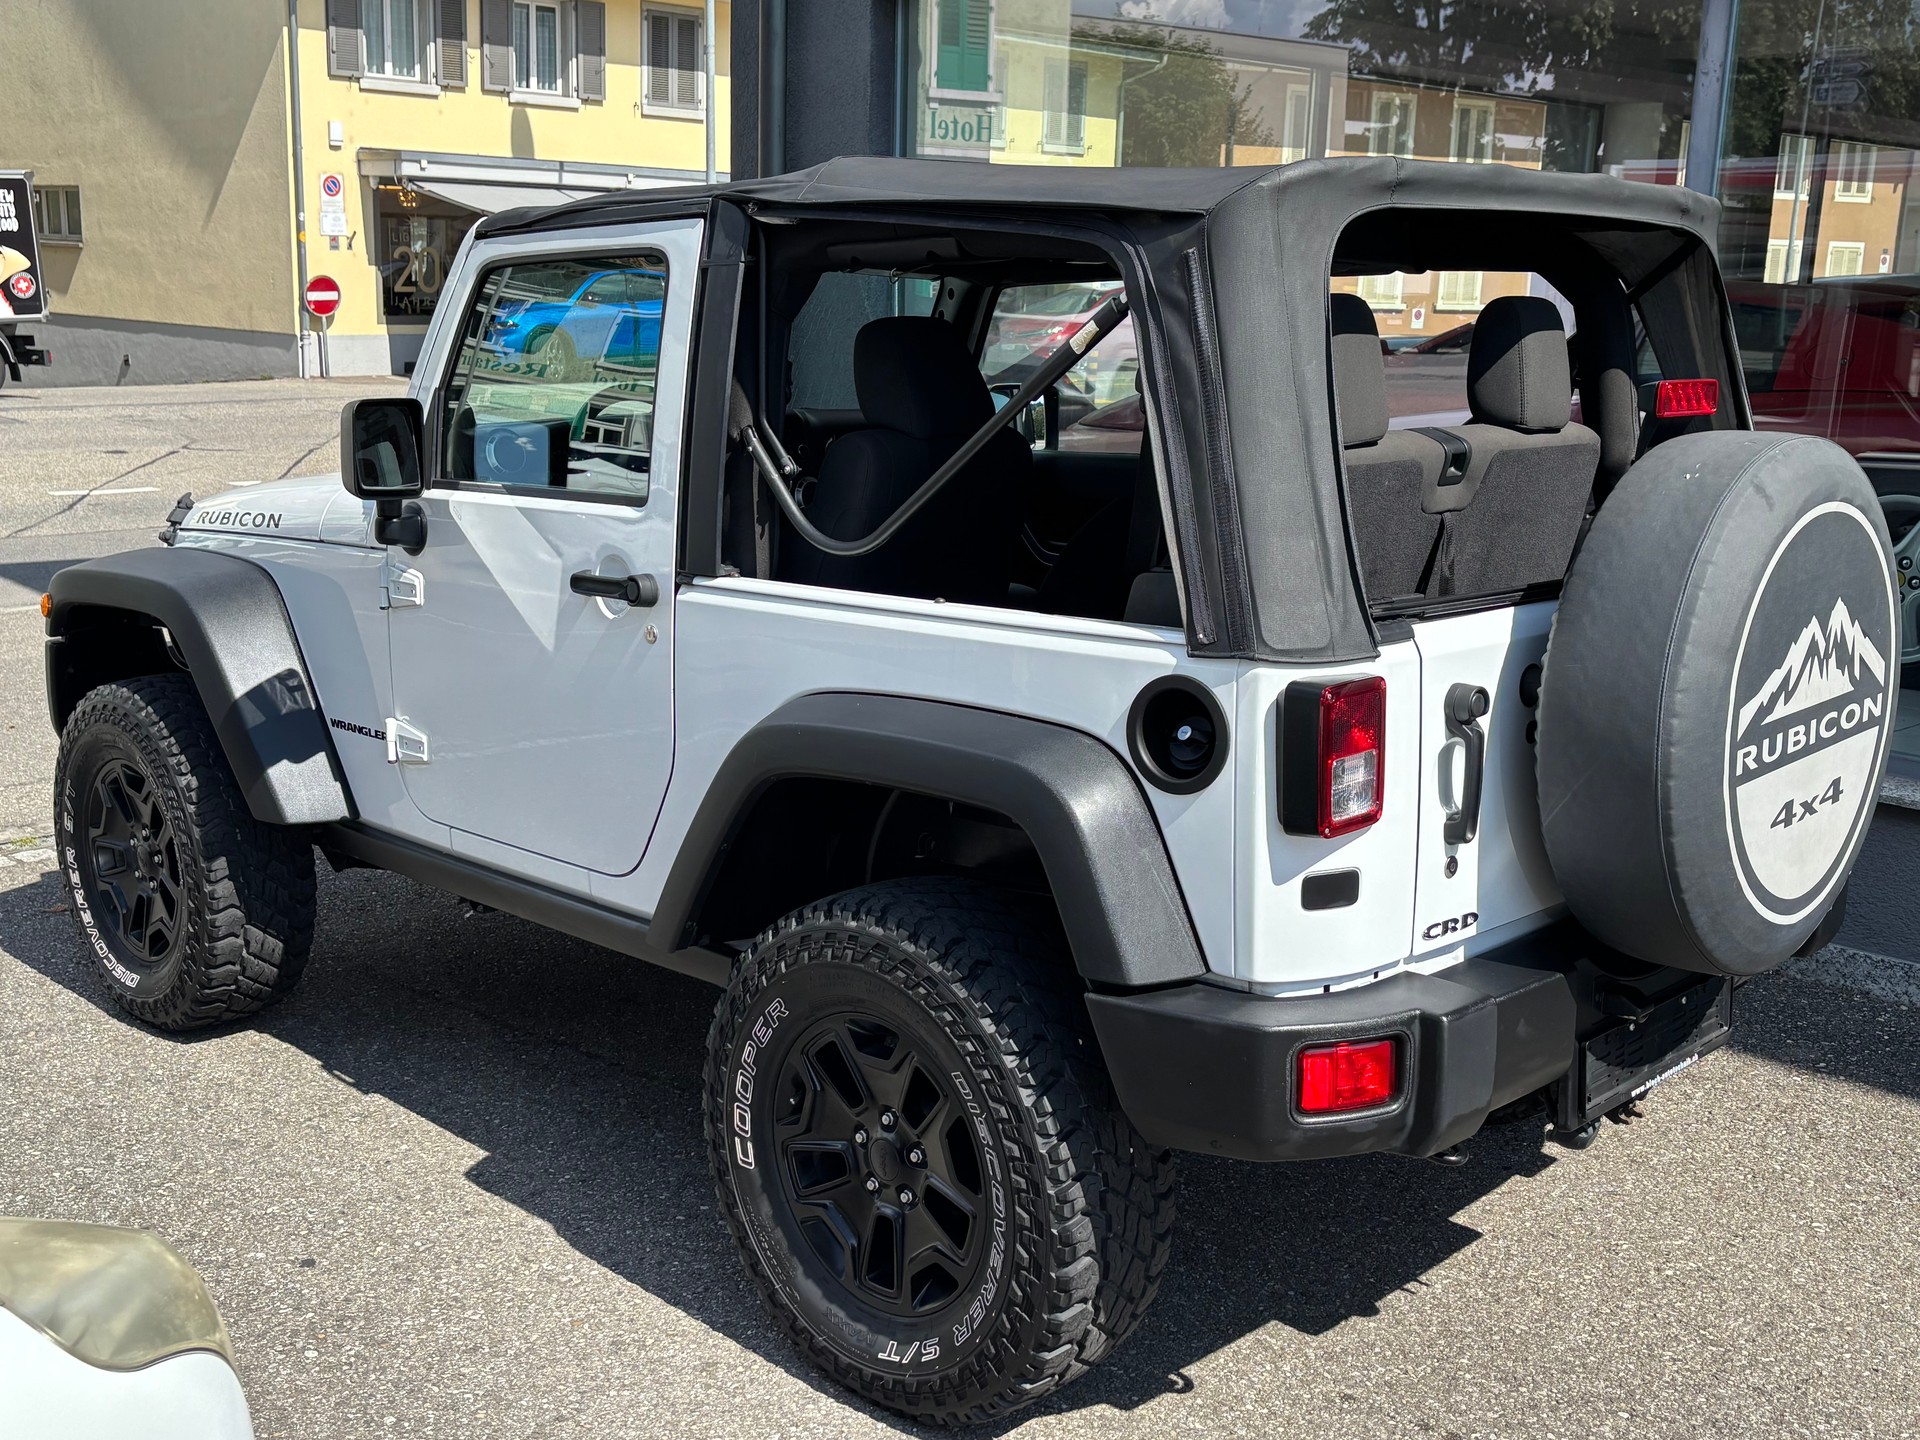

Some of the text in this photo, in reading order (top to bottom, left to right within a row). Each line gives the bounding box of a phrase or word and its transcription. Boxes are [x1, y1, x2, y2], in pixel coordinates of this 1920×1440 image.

[0, 217, 20, 232] OOD
[393, 245, 440, 293] 20
[196, 511, 282, 529] RUBICON
[330, 717, 387, 741] WRANGLER
[1735, 692, 1883, 777] RUBICON
[1770, 776, 1844, 829] 4x4
[64, 778, 141, 988] DISCOVERER S/T
[1422, 911, 1479, 941] CRD
[734, 997, 789, 1170] COOPER
[951, 1071, 1006, 1346] DISCOVERER
[877, 1336, 940, 1364] S/T
